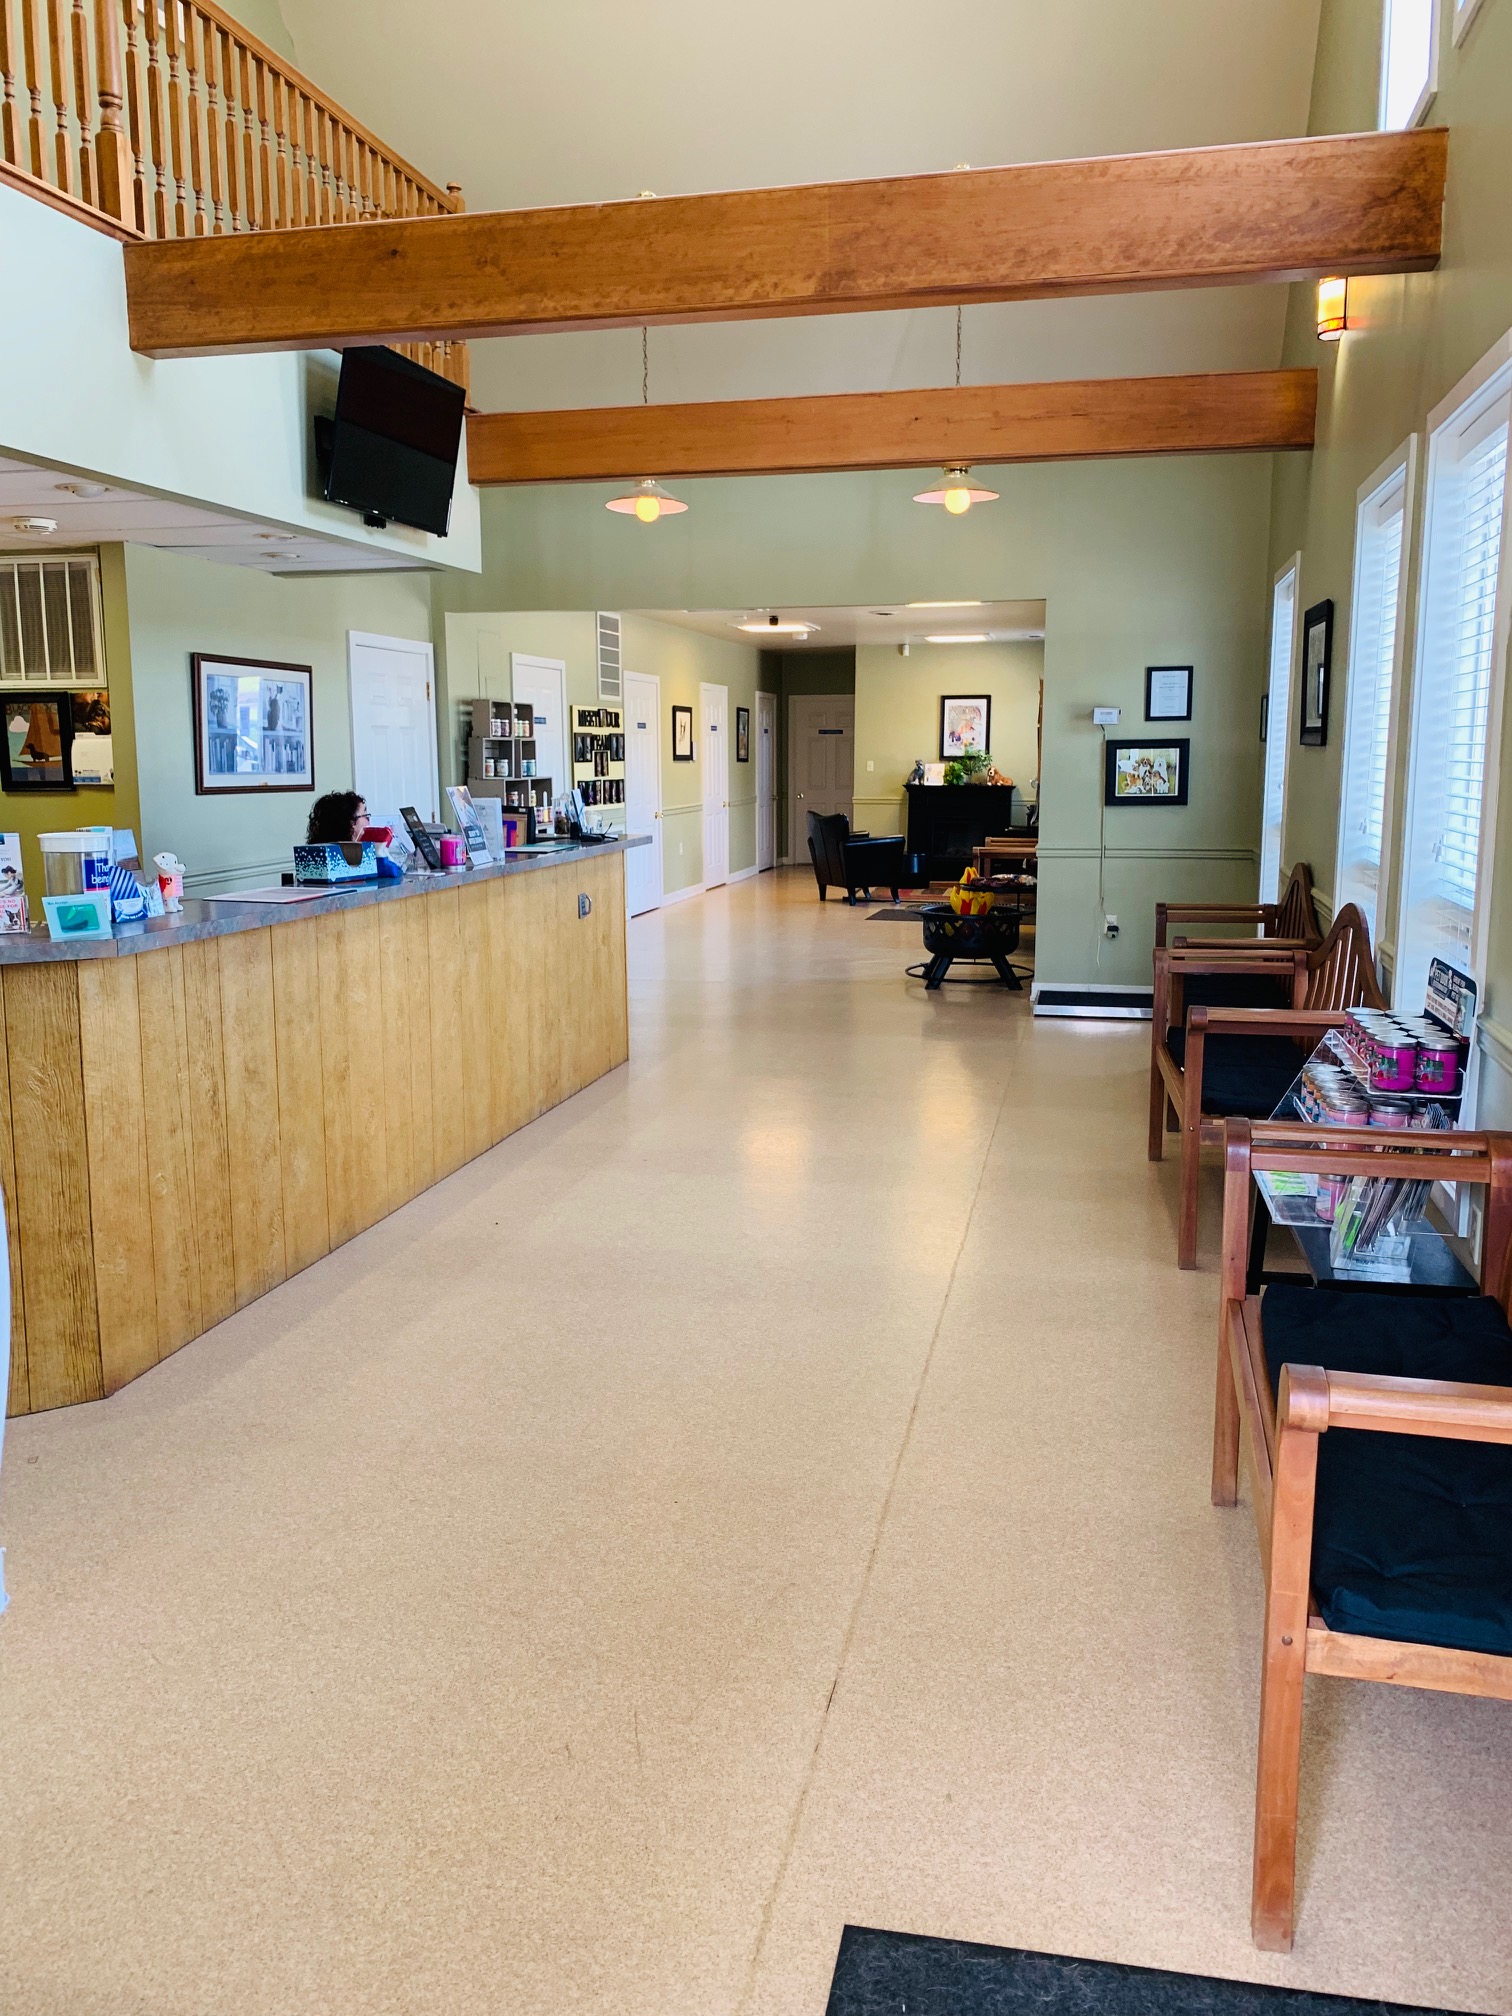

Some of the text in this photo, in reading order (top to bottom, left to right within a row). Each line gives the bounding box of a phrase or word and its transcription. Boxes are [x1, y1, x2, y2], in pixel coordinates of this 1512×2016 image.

[578, 710, 620, 728] MEET OUR
[592, 734, 611, 750] TEAM
